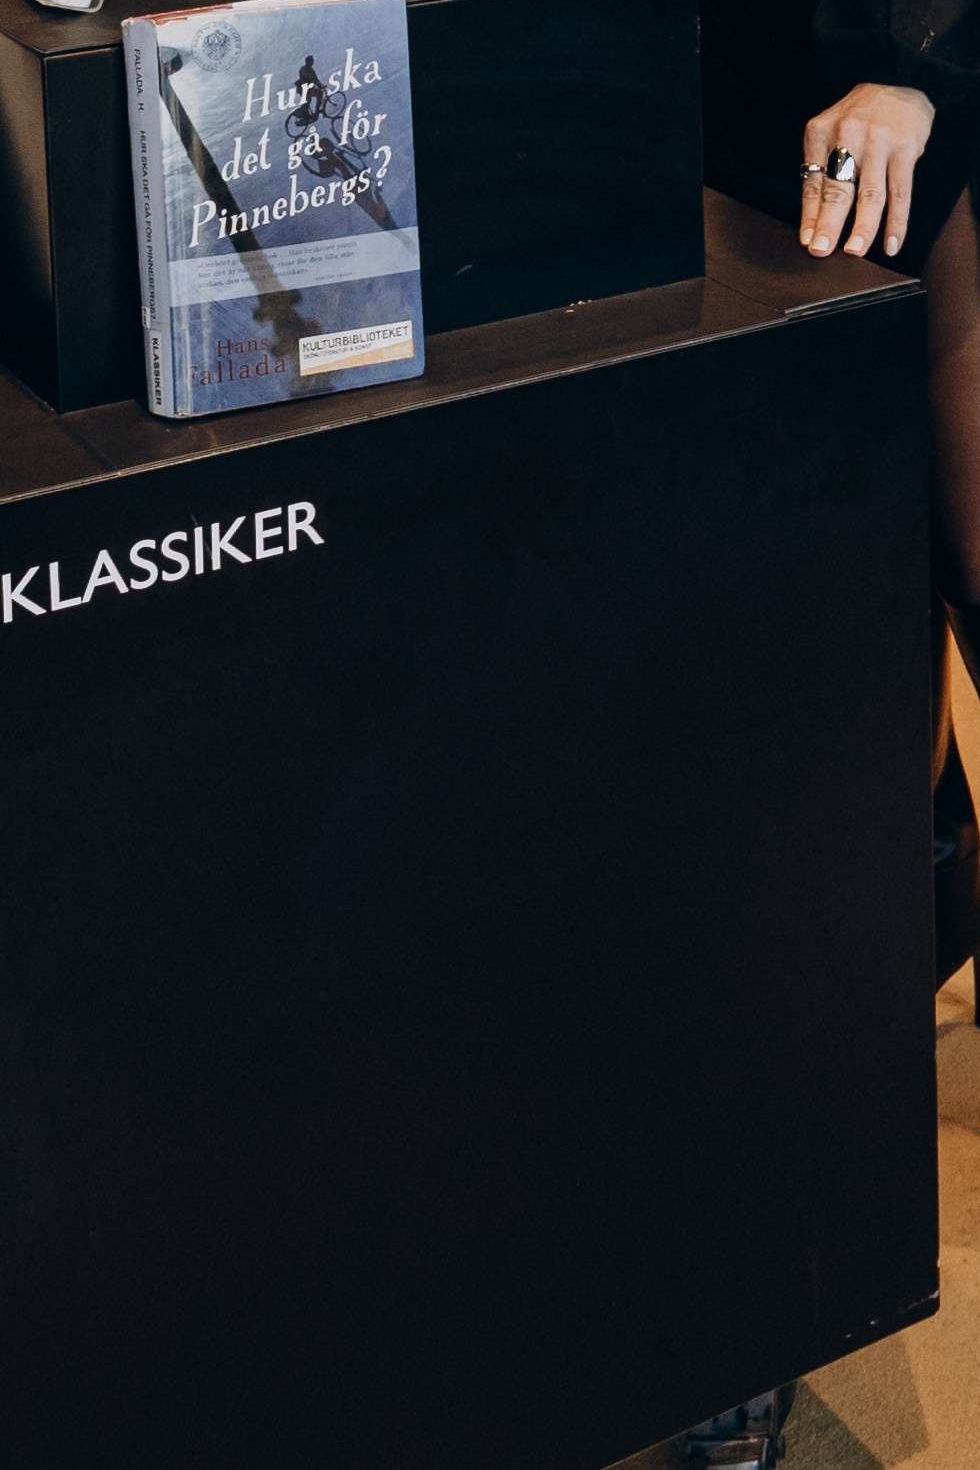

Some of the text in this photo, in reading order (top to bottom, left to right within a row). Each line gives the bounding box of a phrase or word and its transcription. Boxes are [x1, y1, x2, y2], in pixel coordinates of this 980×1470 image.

[242, 48, 382, 123] Hur ska
[139, 130, 147, 154] HUR
[221, 98, 387, 182] det gå för
[188, 145, 392, 248] Pinnebergs?
[152, 337, 162, 406] KLASSIKER
[217, 337, 270, 358] Hans
[302, 325, 409, 353] KULTURBIBLIOTEKET
[1, 501, 324, 624] KLASSIKER
